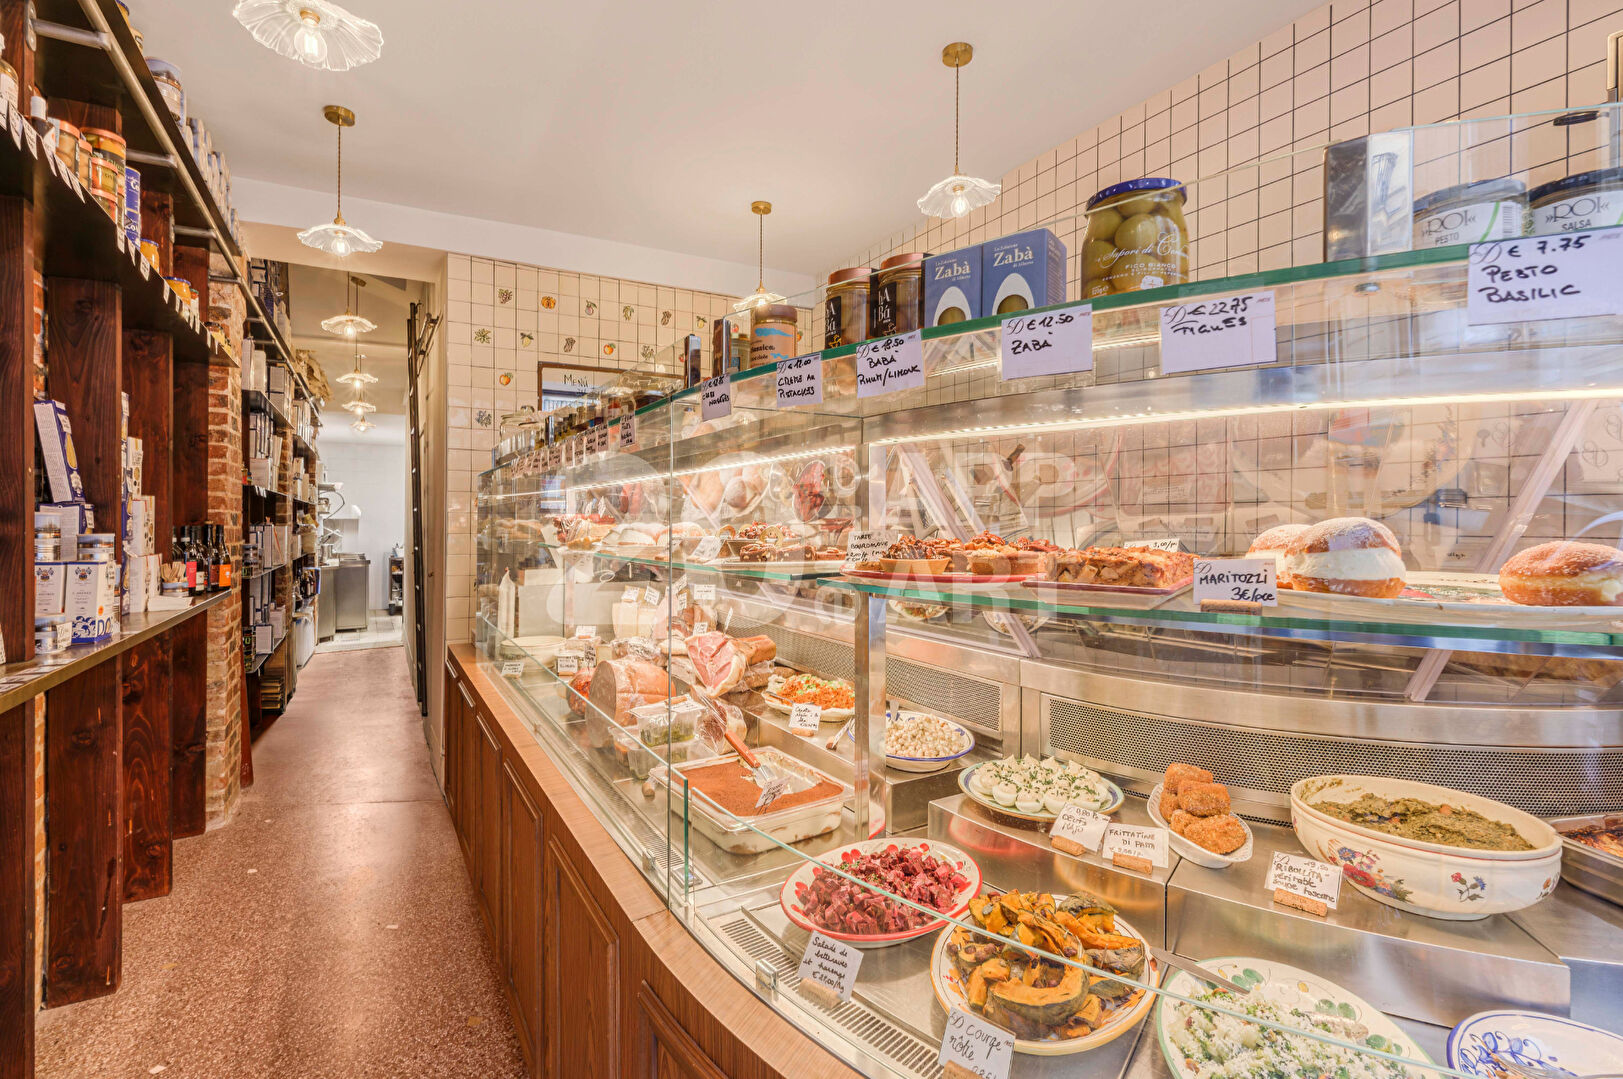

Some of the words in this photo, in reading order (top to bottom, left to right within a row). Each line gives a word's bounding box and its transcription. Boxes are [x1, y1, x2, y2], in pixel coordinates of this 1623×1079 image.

[1561, 219, 1592, 231] SALSA
[1435, 233, 1459, 245] PESTO
[1537, 235, 1591, 254] 7.75
[993, 246, 1034, 267] Zabà
[935, 261, 971, 281] Zabà
[1482, 265, 1558, 283] PESTO
[1478, 284, 1580, 304] BASILIC
